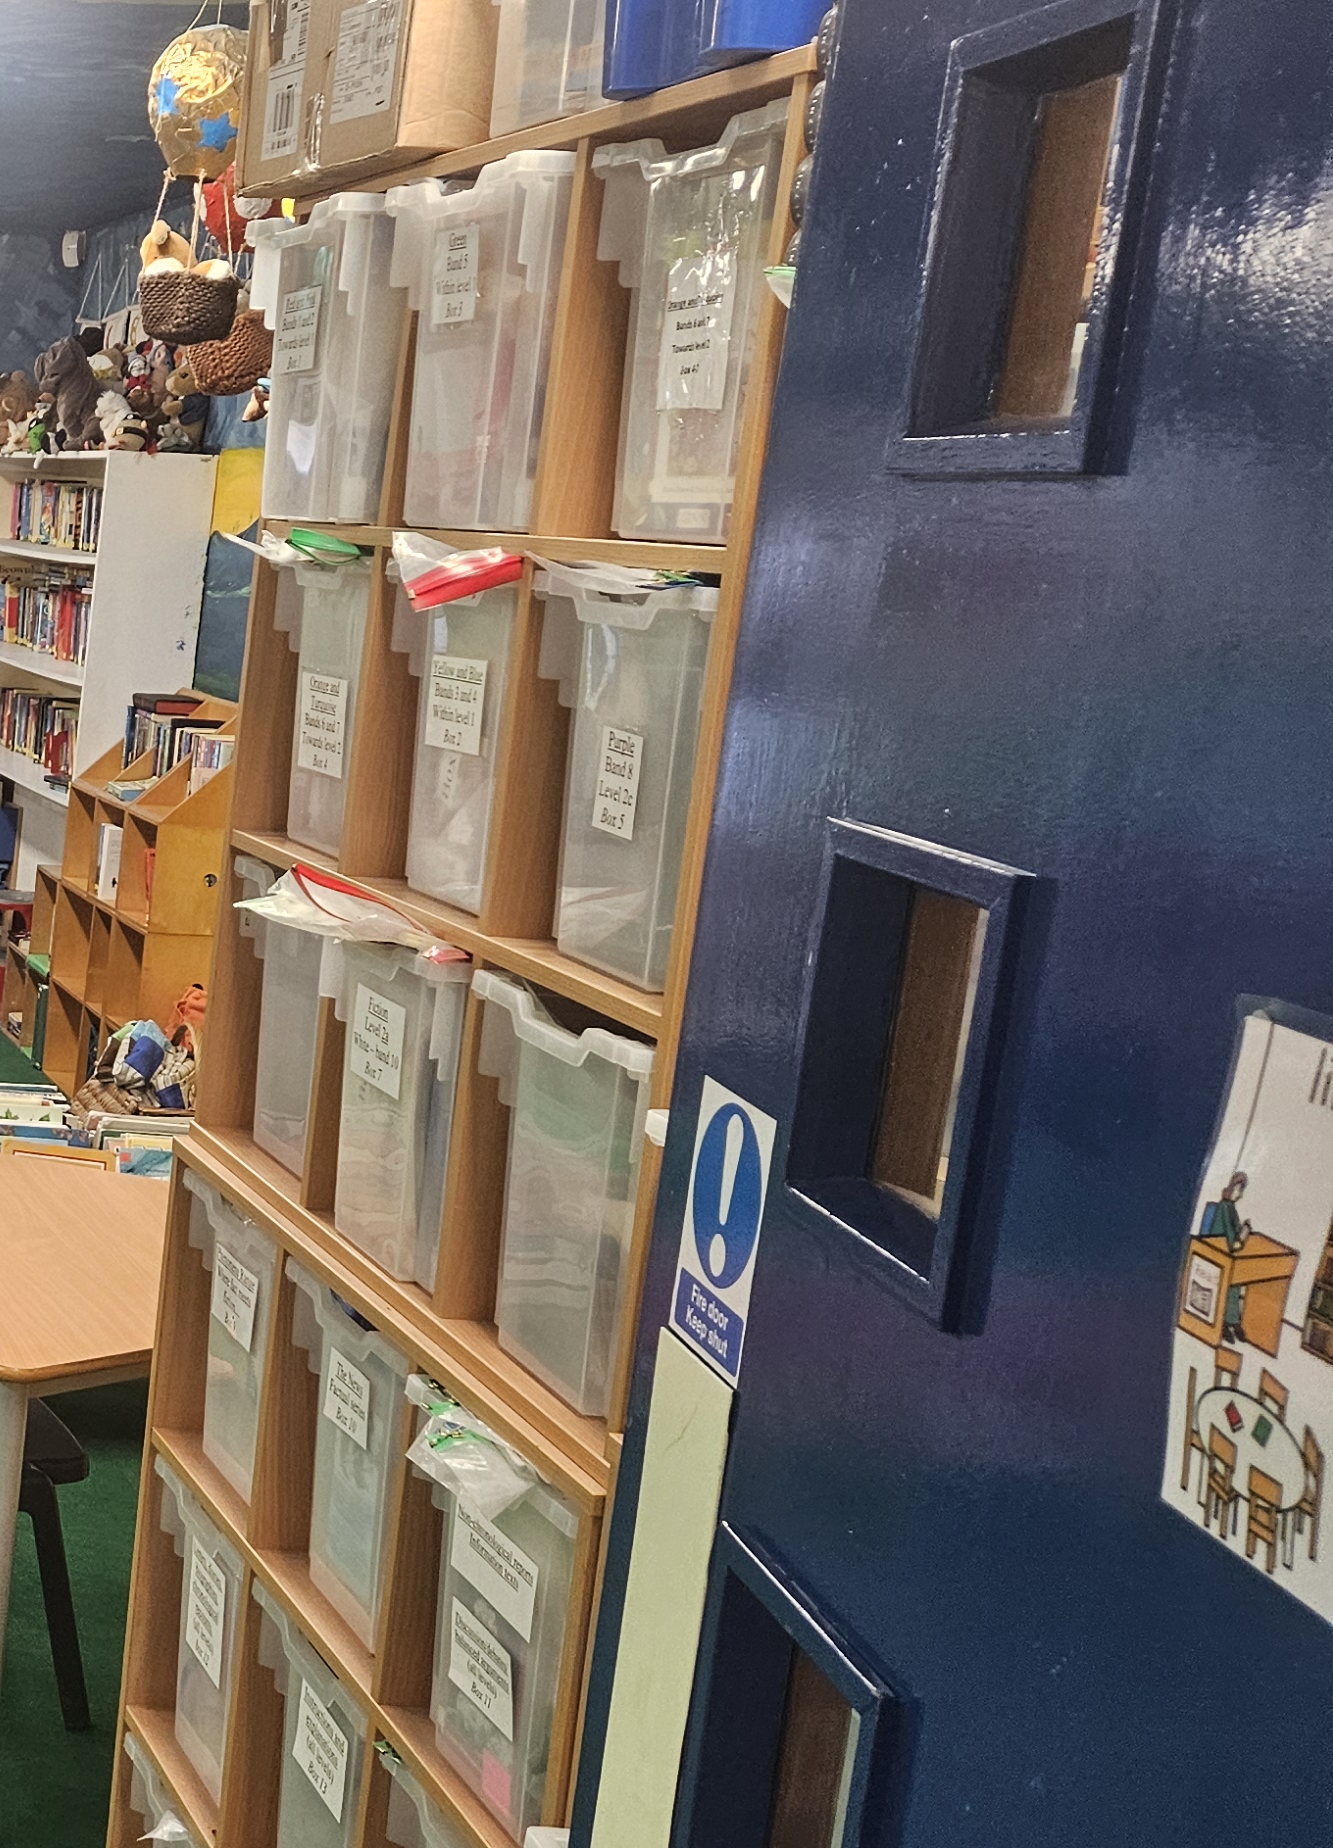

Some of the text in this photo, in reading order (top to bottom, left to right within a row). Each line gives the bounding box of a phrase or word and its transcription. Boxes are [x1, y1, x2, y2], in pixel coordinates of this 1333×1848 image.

[449, 232, 467, 247] Green
[447, 255, 462, 272] Band
[445, 302, 457, 318] Box
[676, 319, 692, 331] Bands
[672, 342, 694, 353] Towards
[287, 356, 296, 370] Box
[433, 660, 483, 682] Yellow and Blue
[310, 676, 329, 691] Orange
[435, 682, 454, 700] Bands
[460, 688, 472, 703] and
[305, 713, 320, 729] Bands
[326, 720, 335, 733] and
[433, 704, 454, 721] Within
[455, 708, 470, 725] level
[302, 731, 323, 749] Towards
[324, 737, 336, 754] level
[443, 728, 456, 744] Box
[608, 731, 635, 756] Purple
[313, 754, 323, 768] Box
[605, 755, 634, 780] Band 8
[598, 780, 633, 807] Level 2c
[600, 807, 625, 830] Box 5
[368, 996, 388, 1020] Fiction
[364, 1016, 389, 1043] Level 2a
[354, 1031, 369, 1053] White
[375, 1044, 390, 1065] band
[391, 1054, 399, 1070] 10
[364, 1060, 383, 1081] Box 7
[691, 1283, 729, 1331] Fire door
[686, 1304, 728, 1358] Keep shut
[337, 1361, 364, 1398] The News
[329, 1378, 365, 1421] Factual series
[336, 1406, 357, 1434] Box 10
[469, 1532, 519, 1592] Information texts
[513, 1558, 533, 1587] reports
[471, 1681, 491, 1709] Box 11
[308, 1760, 327, 1794] Box 13
